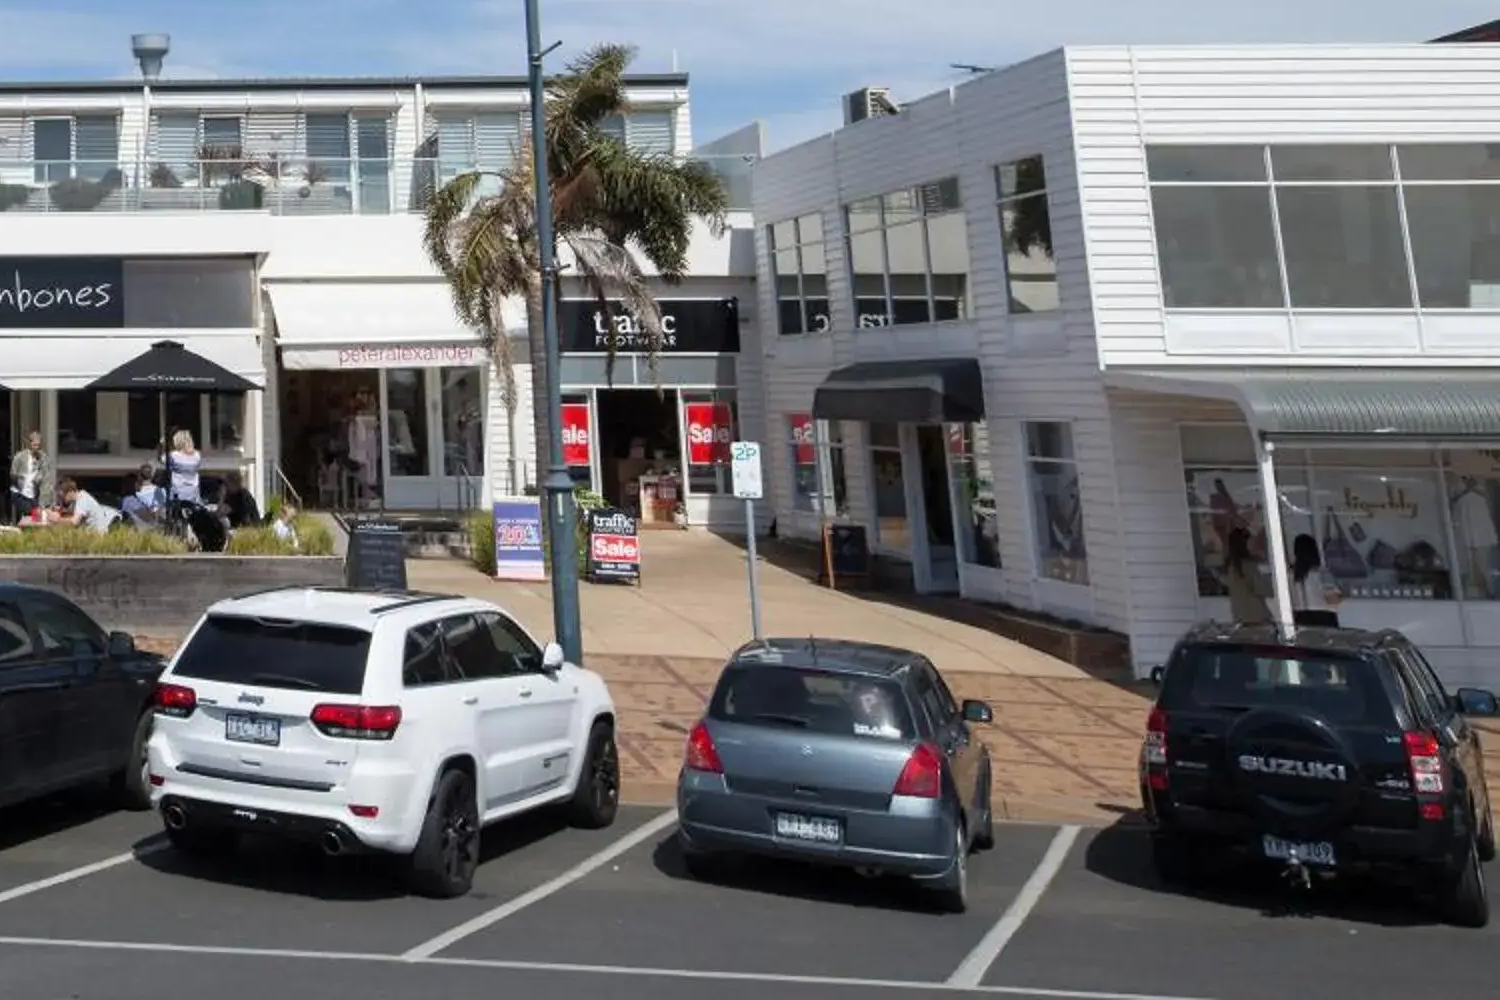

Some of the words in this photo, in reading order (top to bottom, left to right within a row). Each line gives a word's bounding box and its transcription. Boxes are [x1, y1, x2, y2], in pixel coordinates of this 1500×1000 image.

[561, 424, 588, 445] ale
[689, 422, 729, 444] Sale
[594, 513, 634, 528] traffic
[596, 537, 636, 558] Sale
[1238, 755, 1346, 781] SUZUKI
